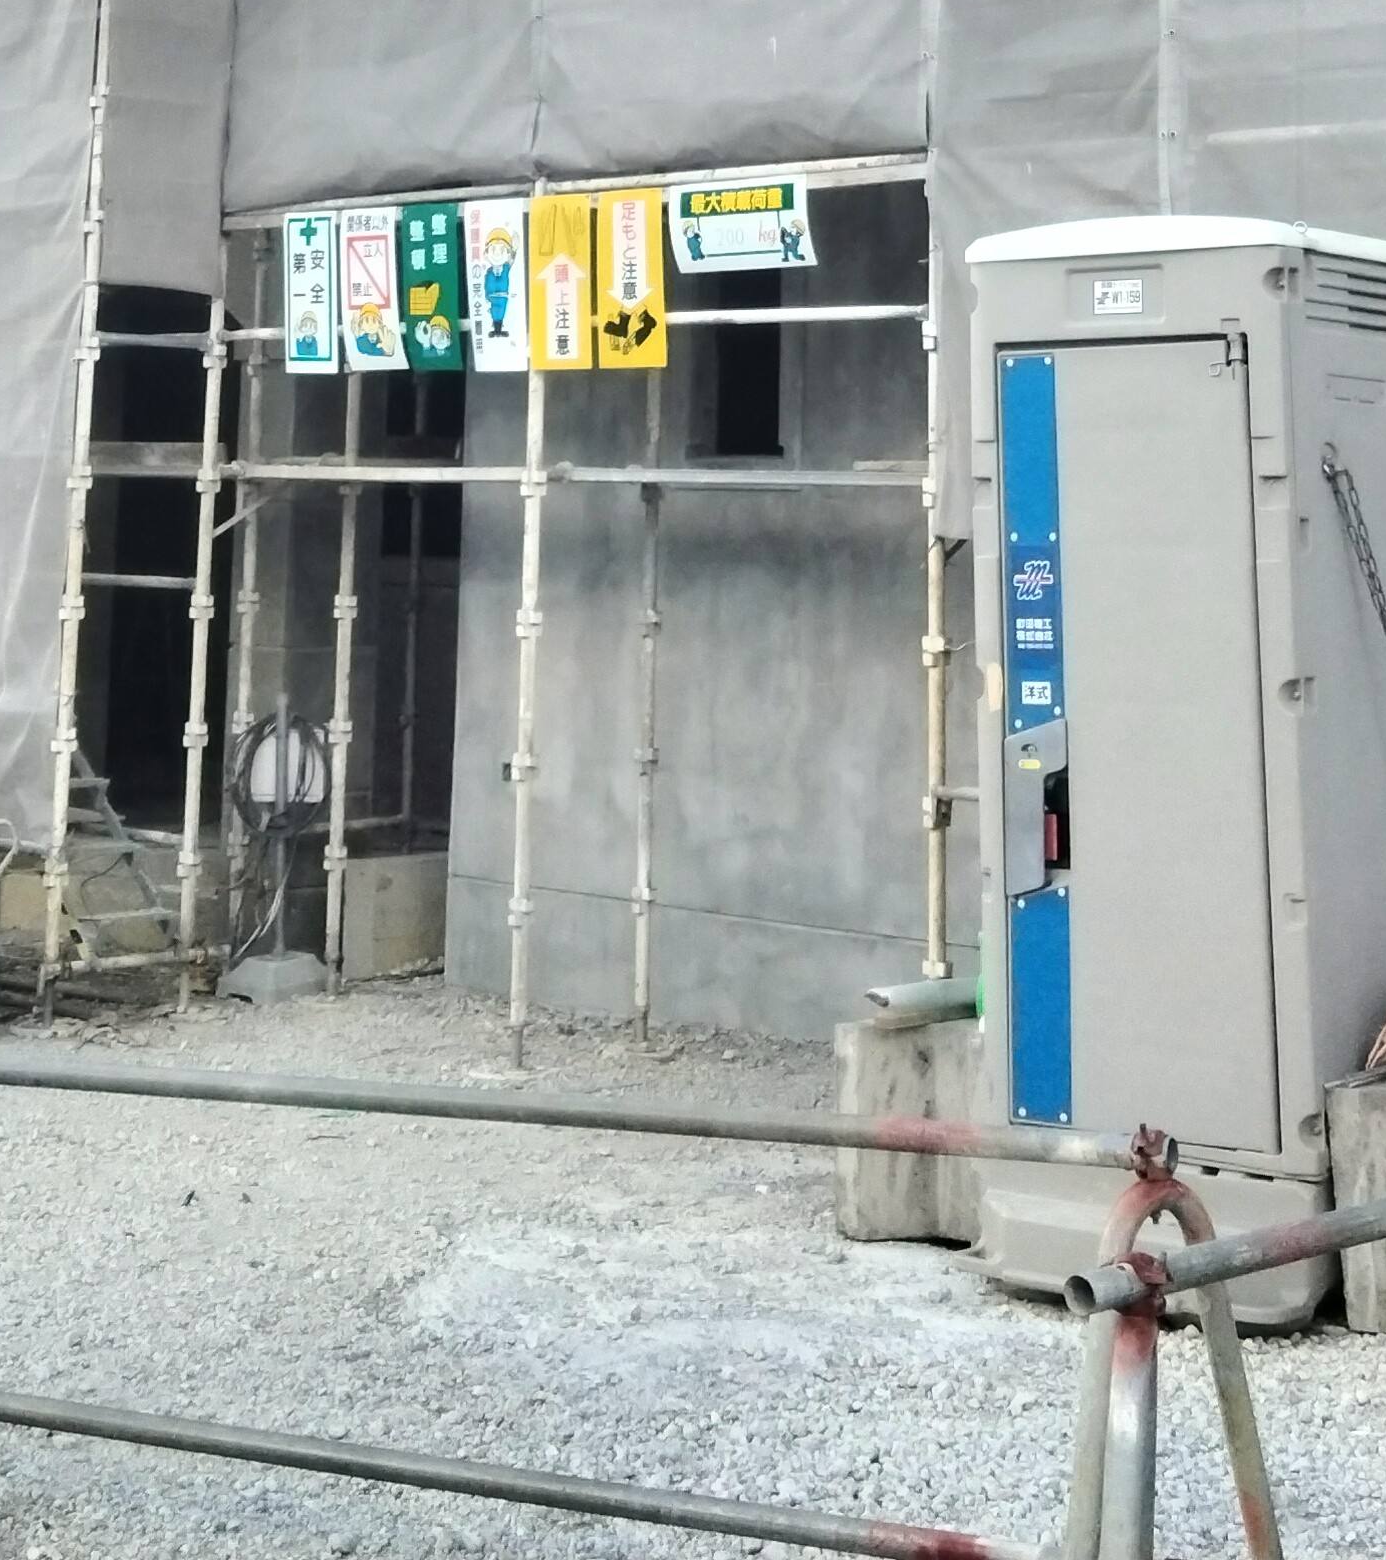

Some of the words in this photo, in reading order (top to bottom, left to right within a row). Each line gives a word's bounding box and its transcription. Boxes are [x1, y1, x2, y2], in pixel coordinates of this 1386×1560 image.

[690, 187, 783, 214] 最大積載荷重
[310, 249, 325, 304] 安全
[621, 202, 638, 301] 足もと注意
[553, 263, 570, 356] 頭上注意
[1024, 685, 1049, 700] 洋式
